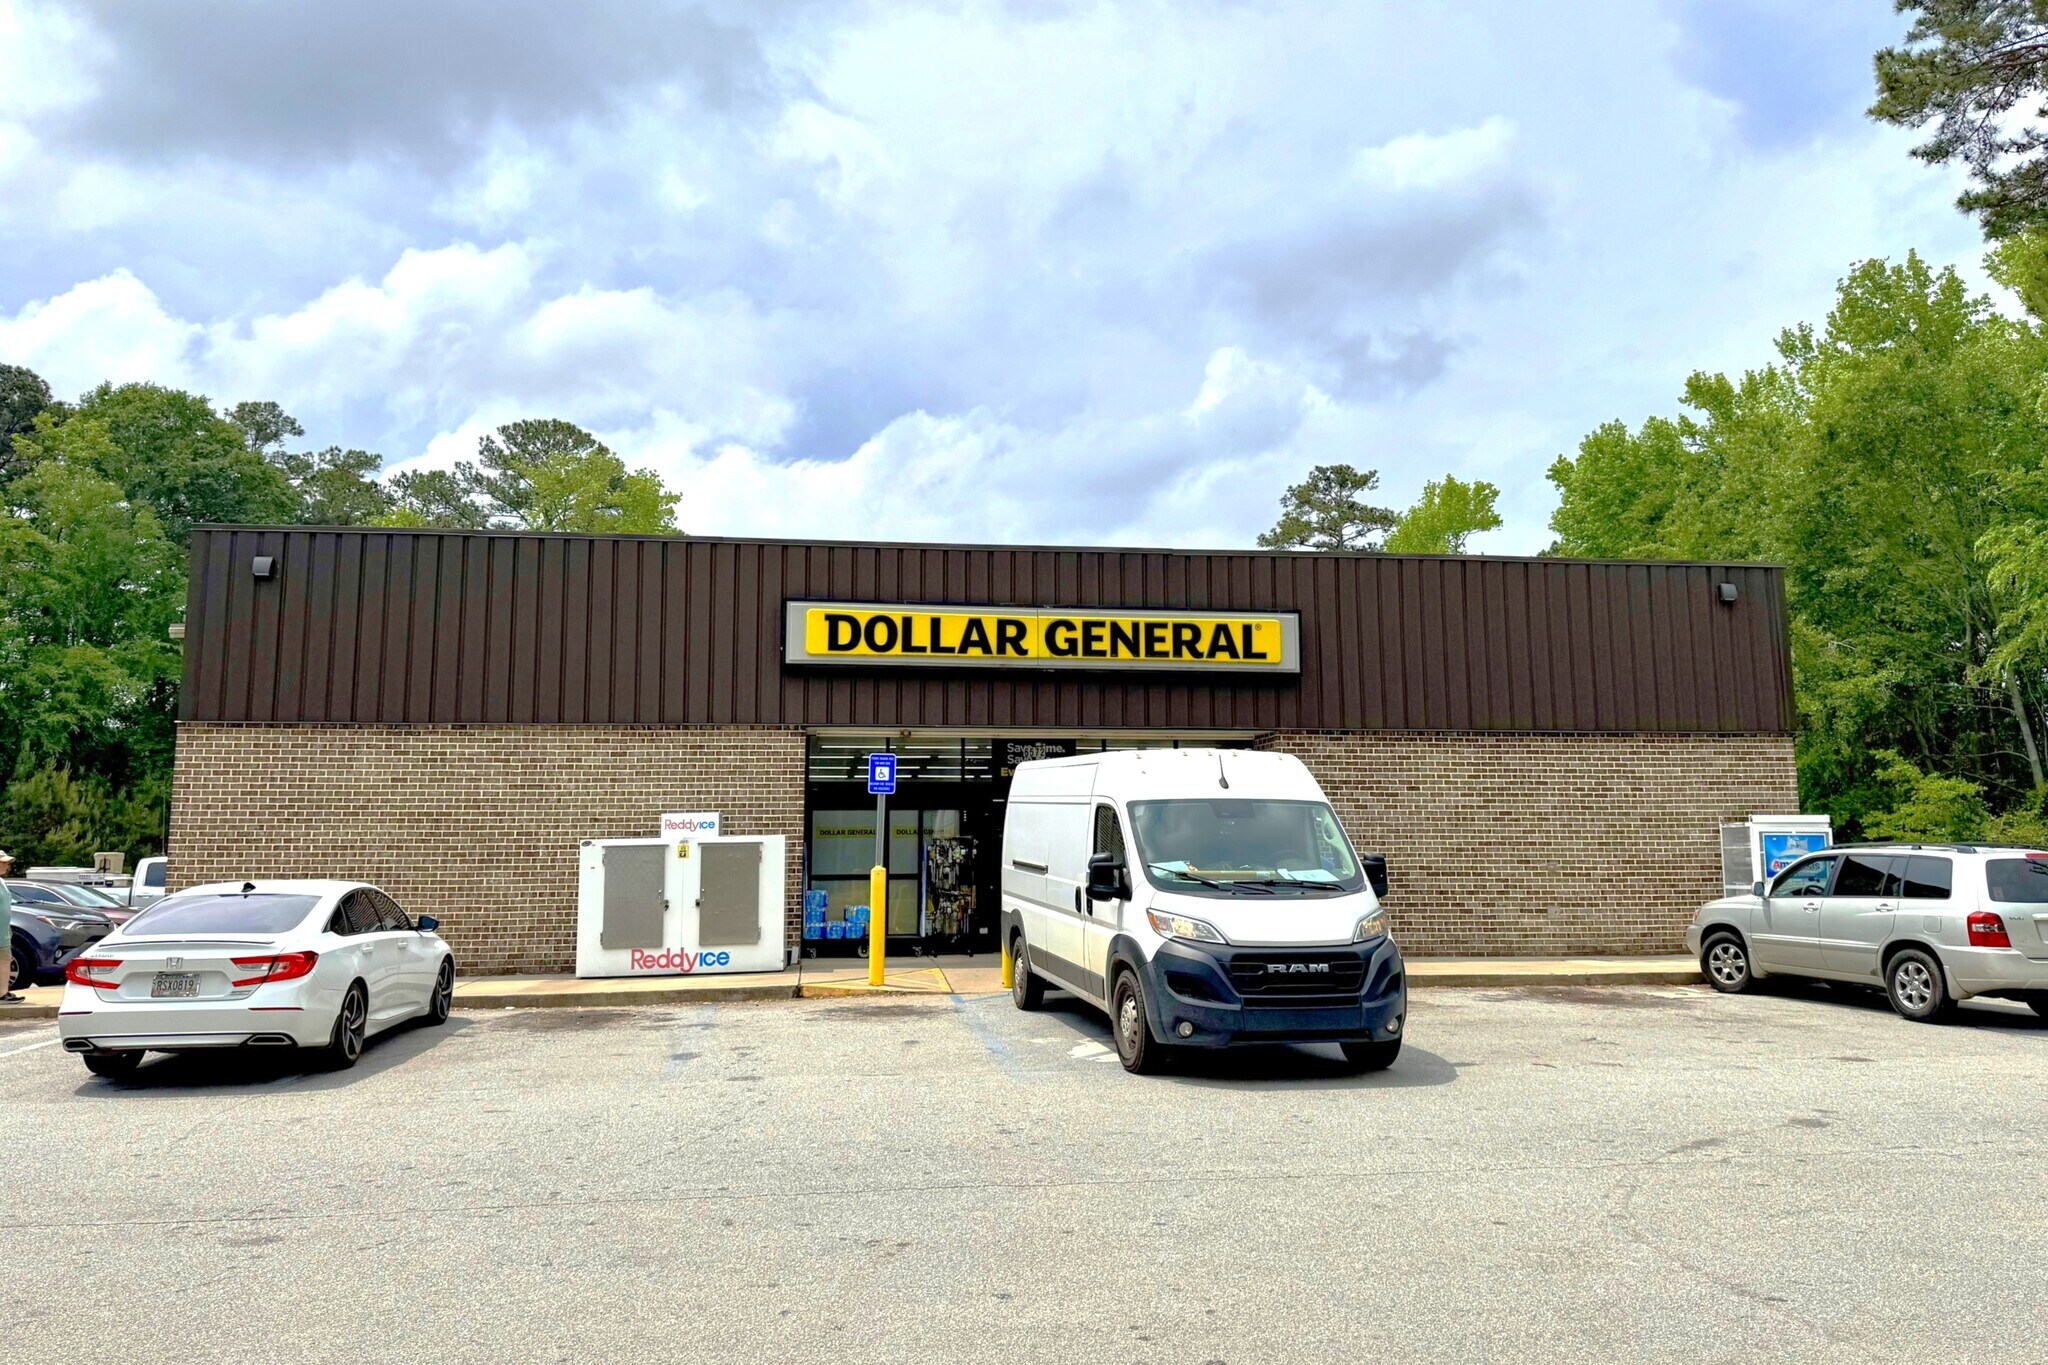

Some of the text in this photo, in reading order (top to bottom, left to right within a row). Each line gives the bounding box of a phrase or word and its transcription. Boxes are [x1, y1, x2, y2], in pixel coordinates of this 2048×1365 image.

[824, 614, 1268, 660] DOLLAR GENERAL
[1267, 963, 1329, 973] RAM
